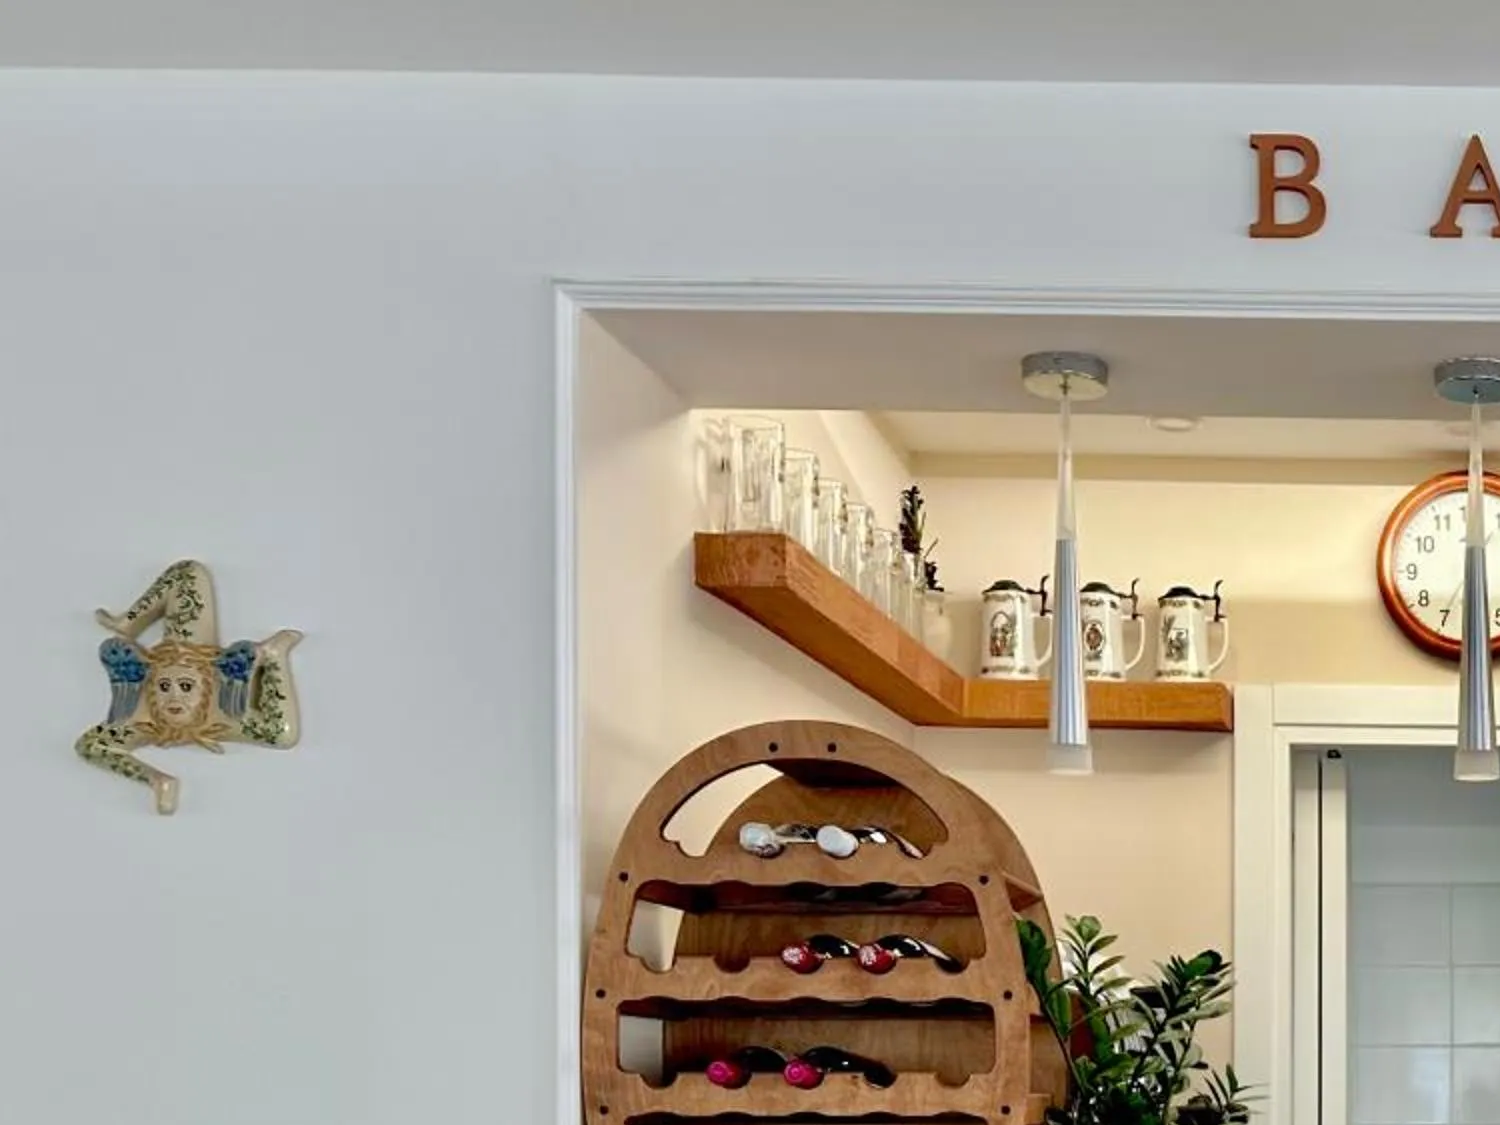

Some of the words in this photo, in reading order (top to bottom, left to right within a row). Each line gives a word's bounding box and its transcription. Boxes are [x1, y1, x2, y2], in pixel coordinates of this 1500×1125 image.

[1434, 514, 1451, 531] 11
[1415, 535, 1435, 553] 10
[1406, 563, 1417, 581] 9
[1417, 589, 1430, 607] 8
[1439, 609, 1451, 627] 7
